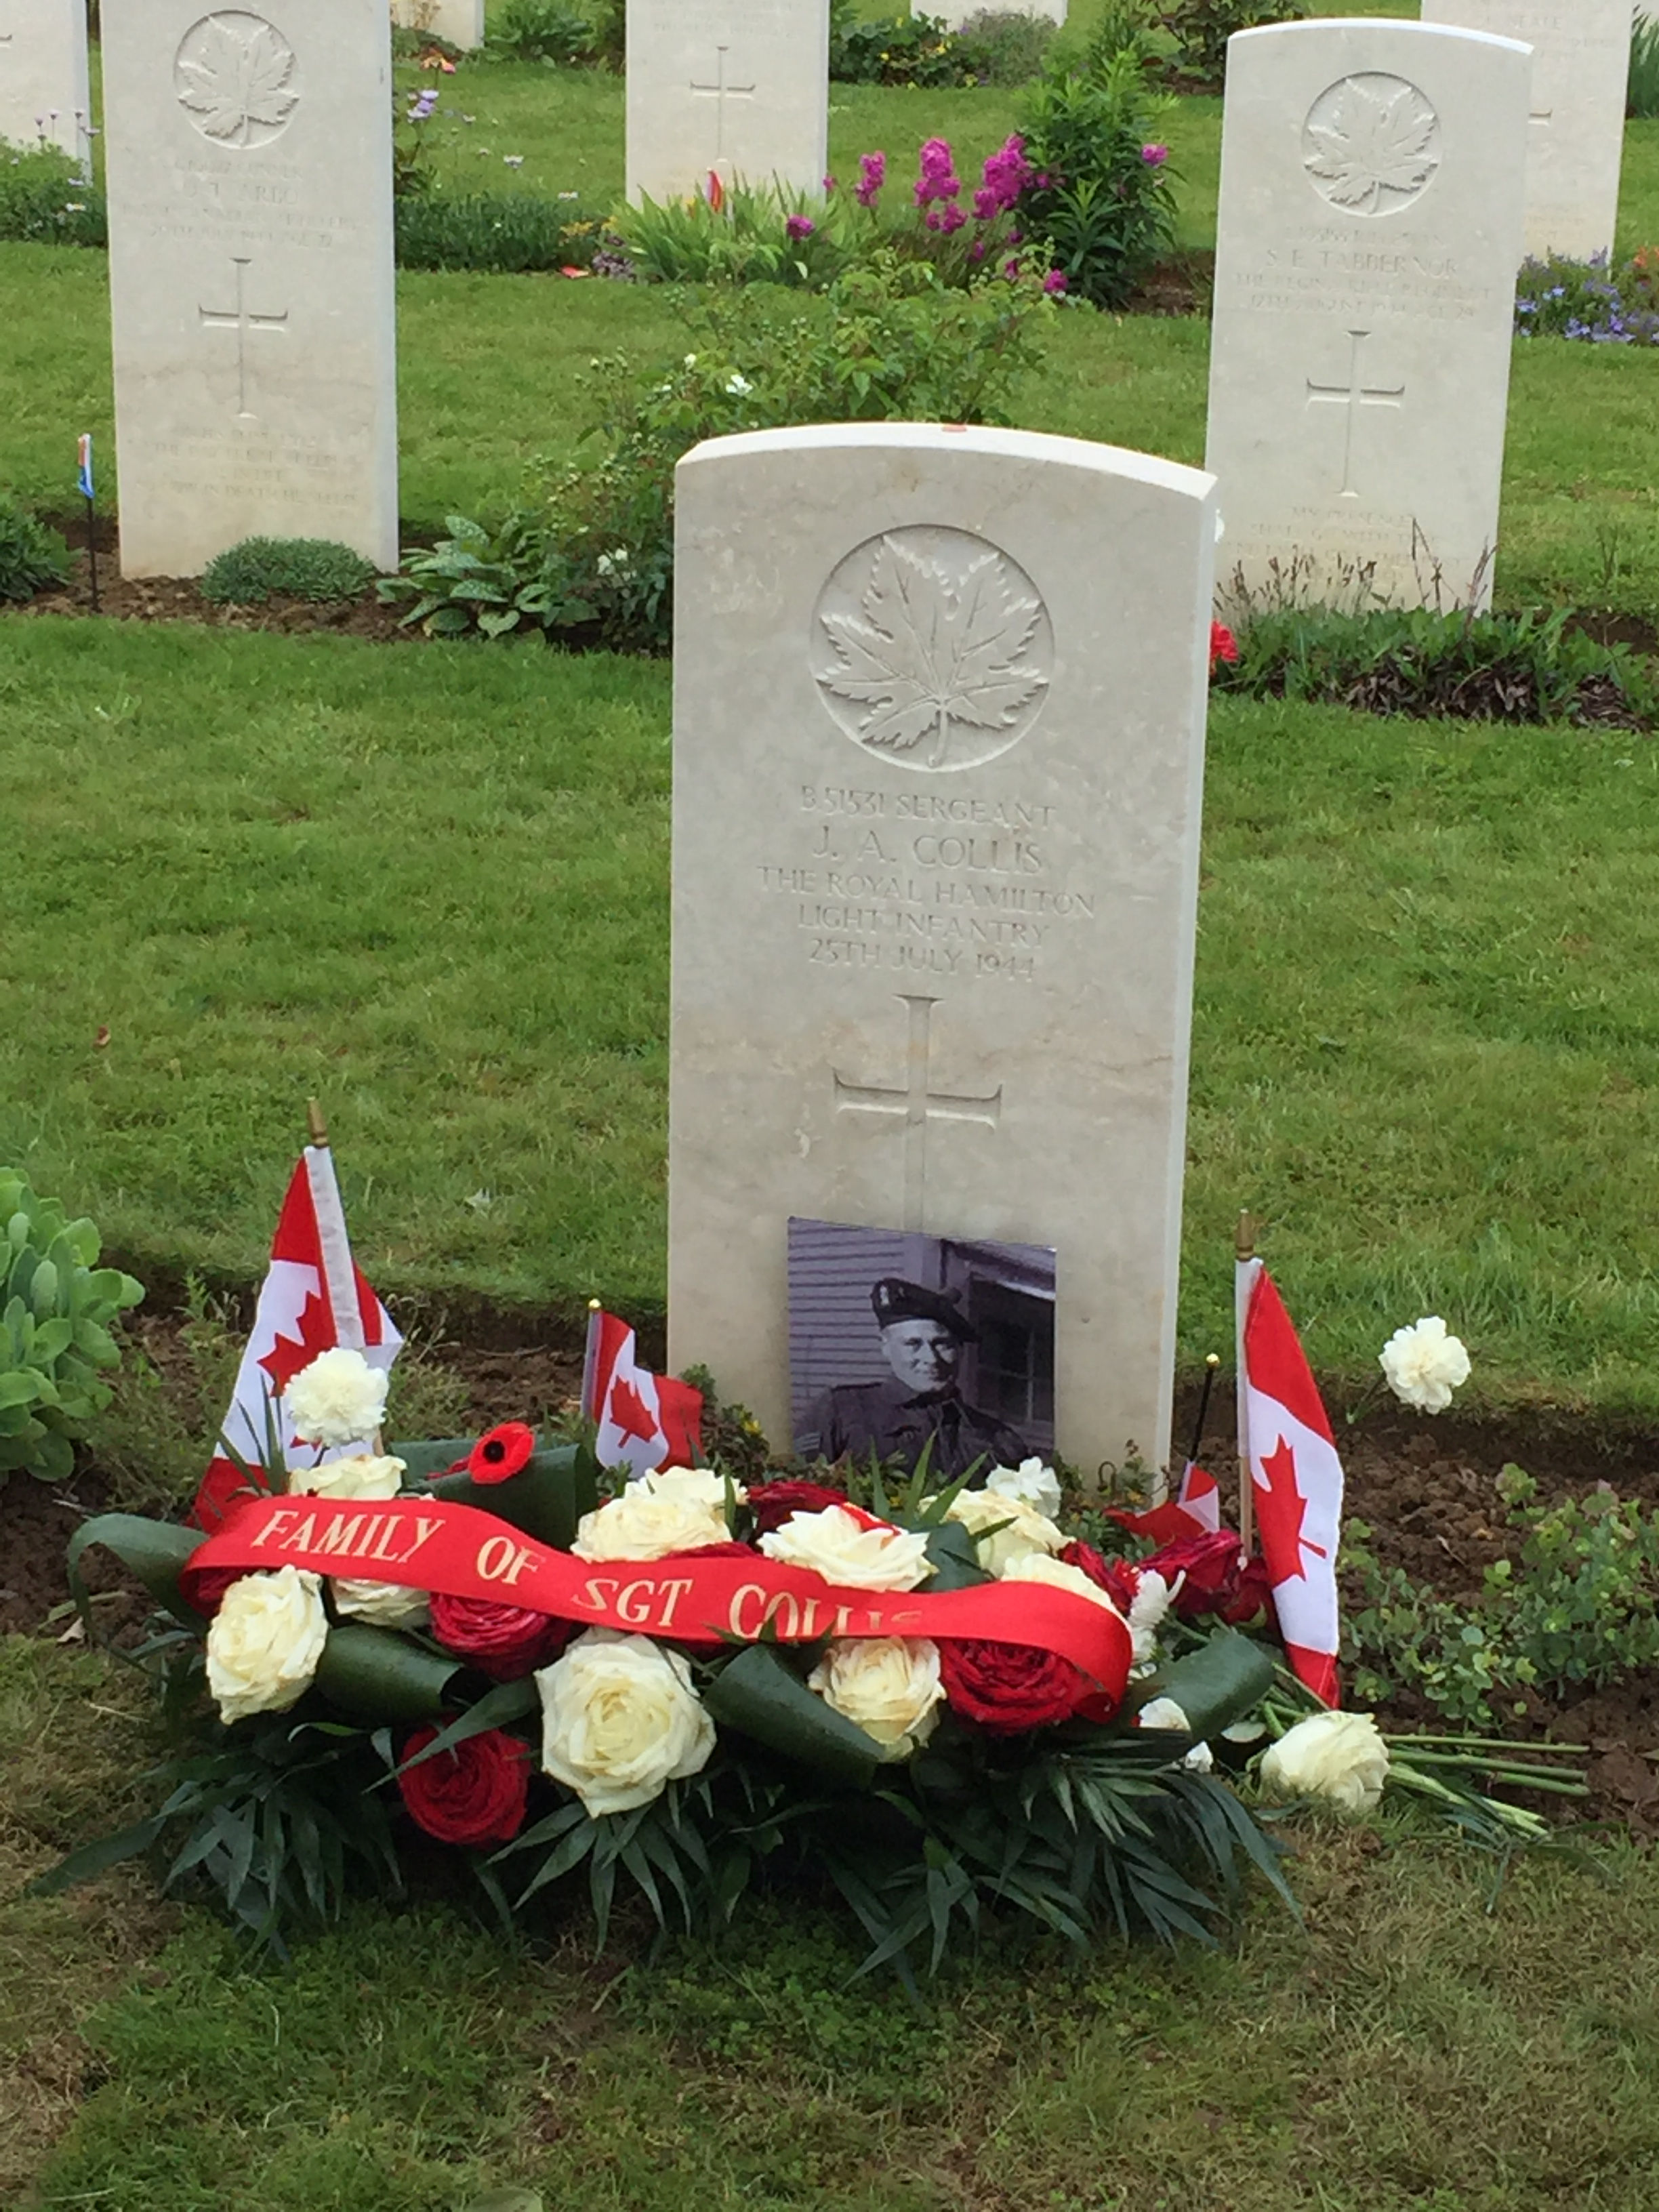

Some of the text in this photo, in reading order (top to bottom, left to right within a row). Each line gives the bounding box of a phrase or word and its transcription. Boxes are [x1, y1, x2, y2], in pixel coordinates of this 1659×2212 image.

[896, 793, 1057, 832] SERGEANT
[813, 825, 1042, 876] J. A. COLLIS
[756, 865, 1096, 920] THE ROYAL HAMILTON
[797, 903, 1050, 949] LIGHT INFANTRY
[808, 938, 1037, 984] 25TH JULY 1944
[249, 1509, 448, 1565] FAMILY
[476, 1534, 541, 1586] OF
[570, 1578, 694, 1627] SGT
